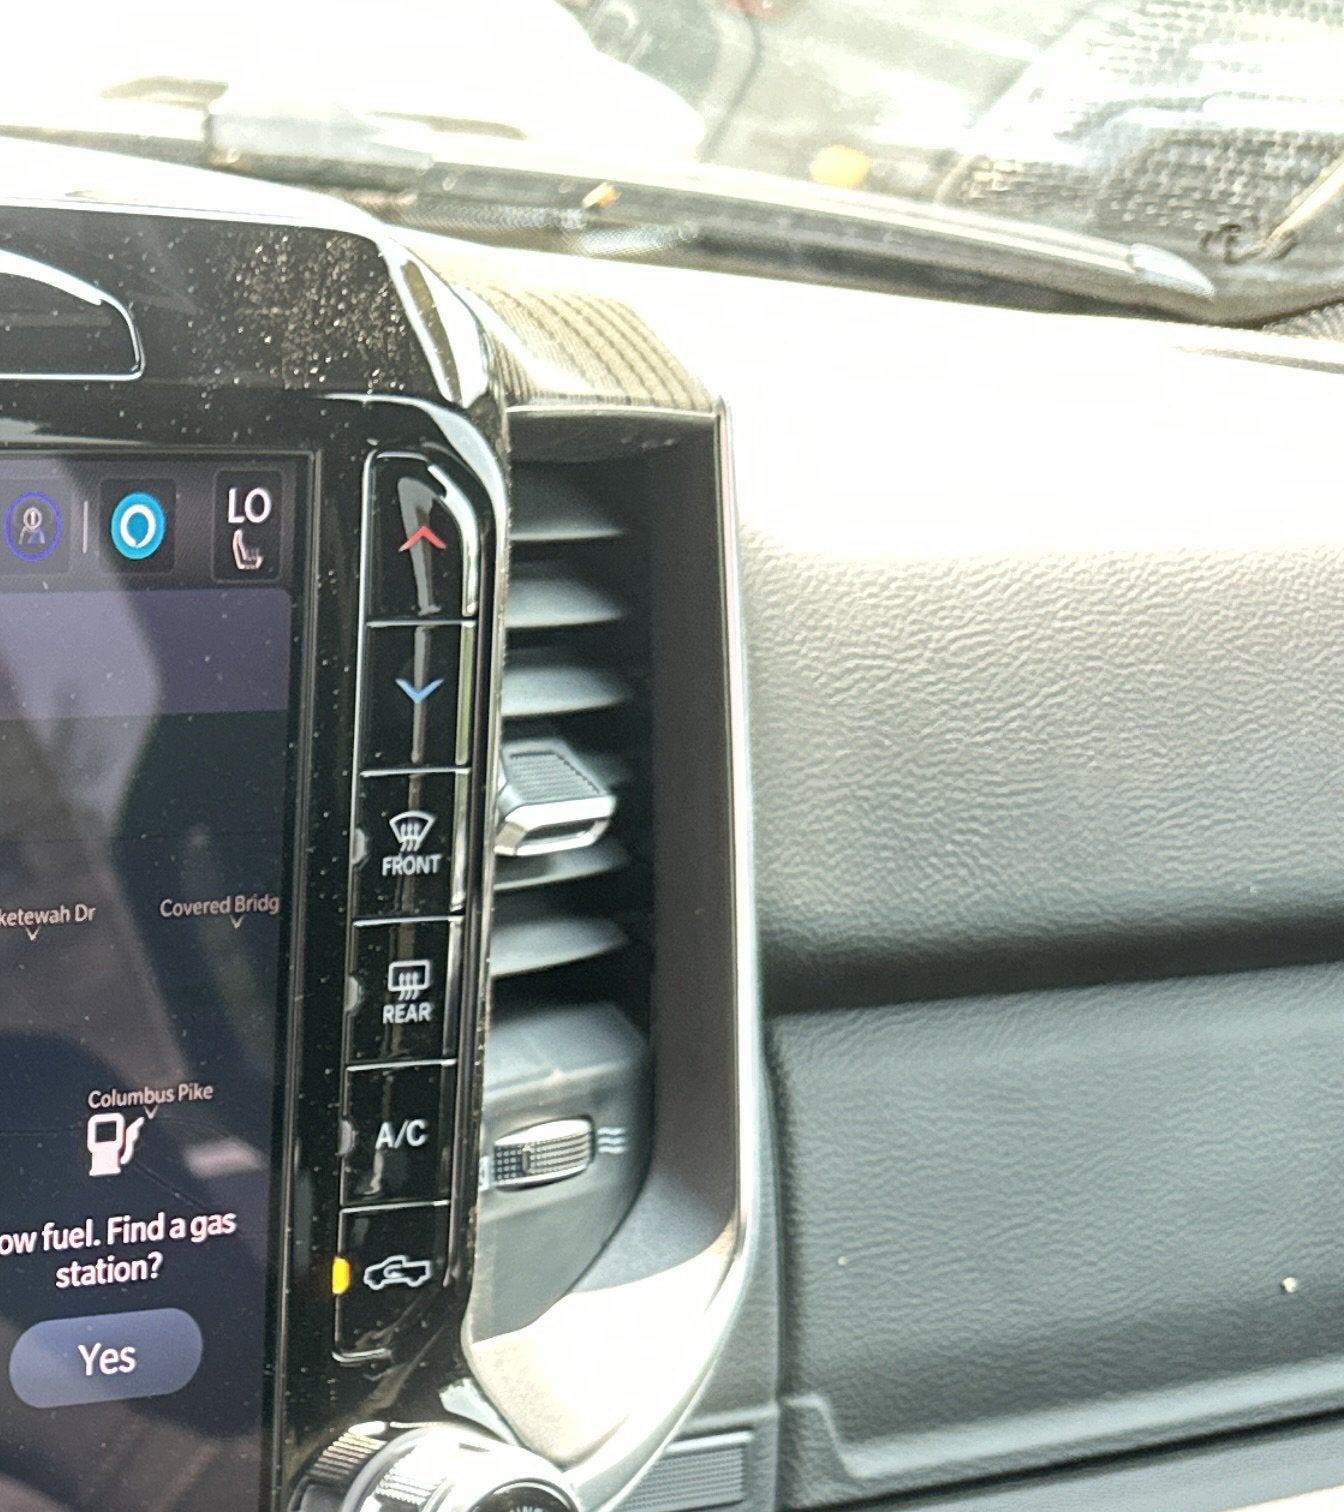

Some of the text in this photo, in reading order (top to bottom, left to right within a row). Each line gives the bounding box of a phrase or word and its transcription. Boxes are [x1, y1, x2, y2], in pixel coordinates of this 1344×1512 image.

[228, 487, 272, 524] LO
[382, 855, 441, 876] FRONT
[74, 904, 96, 924] Dr
[160, 894, 280, 918] Covered Bridg
[382, 1003, 431, 1025] REAR
[88, 1083, 213, 1110] Columbus Pike
[375, 1120, 429, 1149] A/C
[42, 1221, 100, 1251] fuel.
[107, 1213, 165, 1244] Find
[170, 1219, 187, 1240] a
[190, 1212, 237, 1243] gas
[55, 1251, 163, 1289] station?
[78, 1342, 136, 1376] Yes
